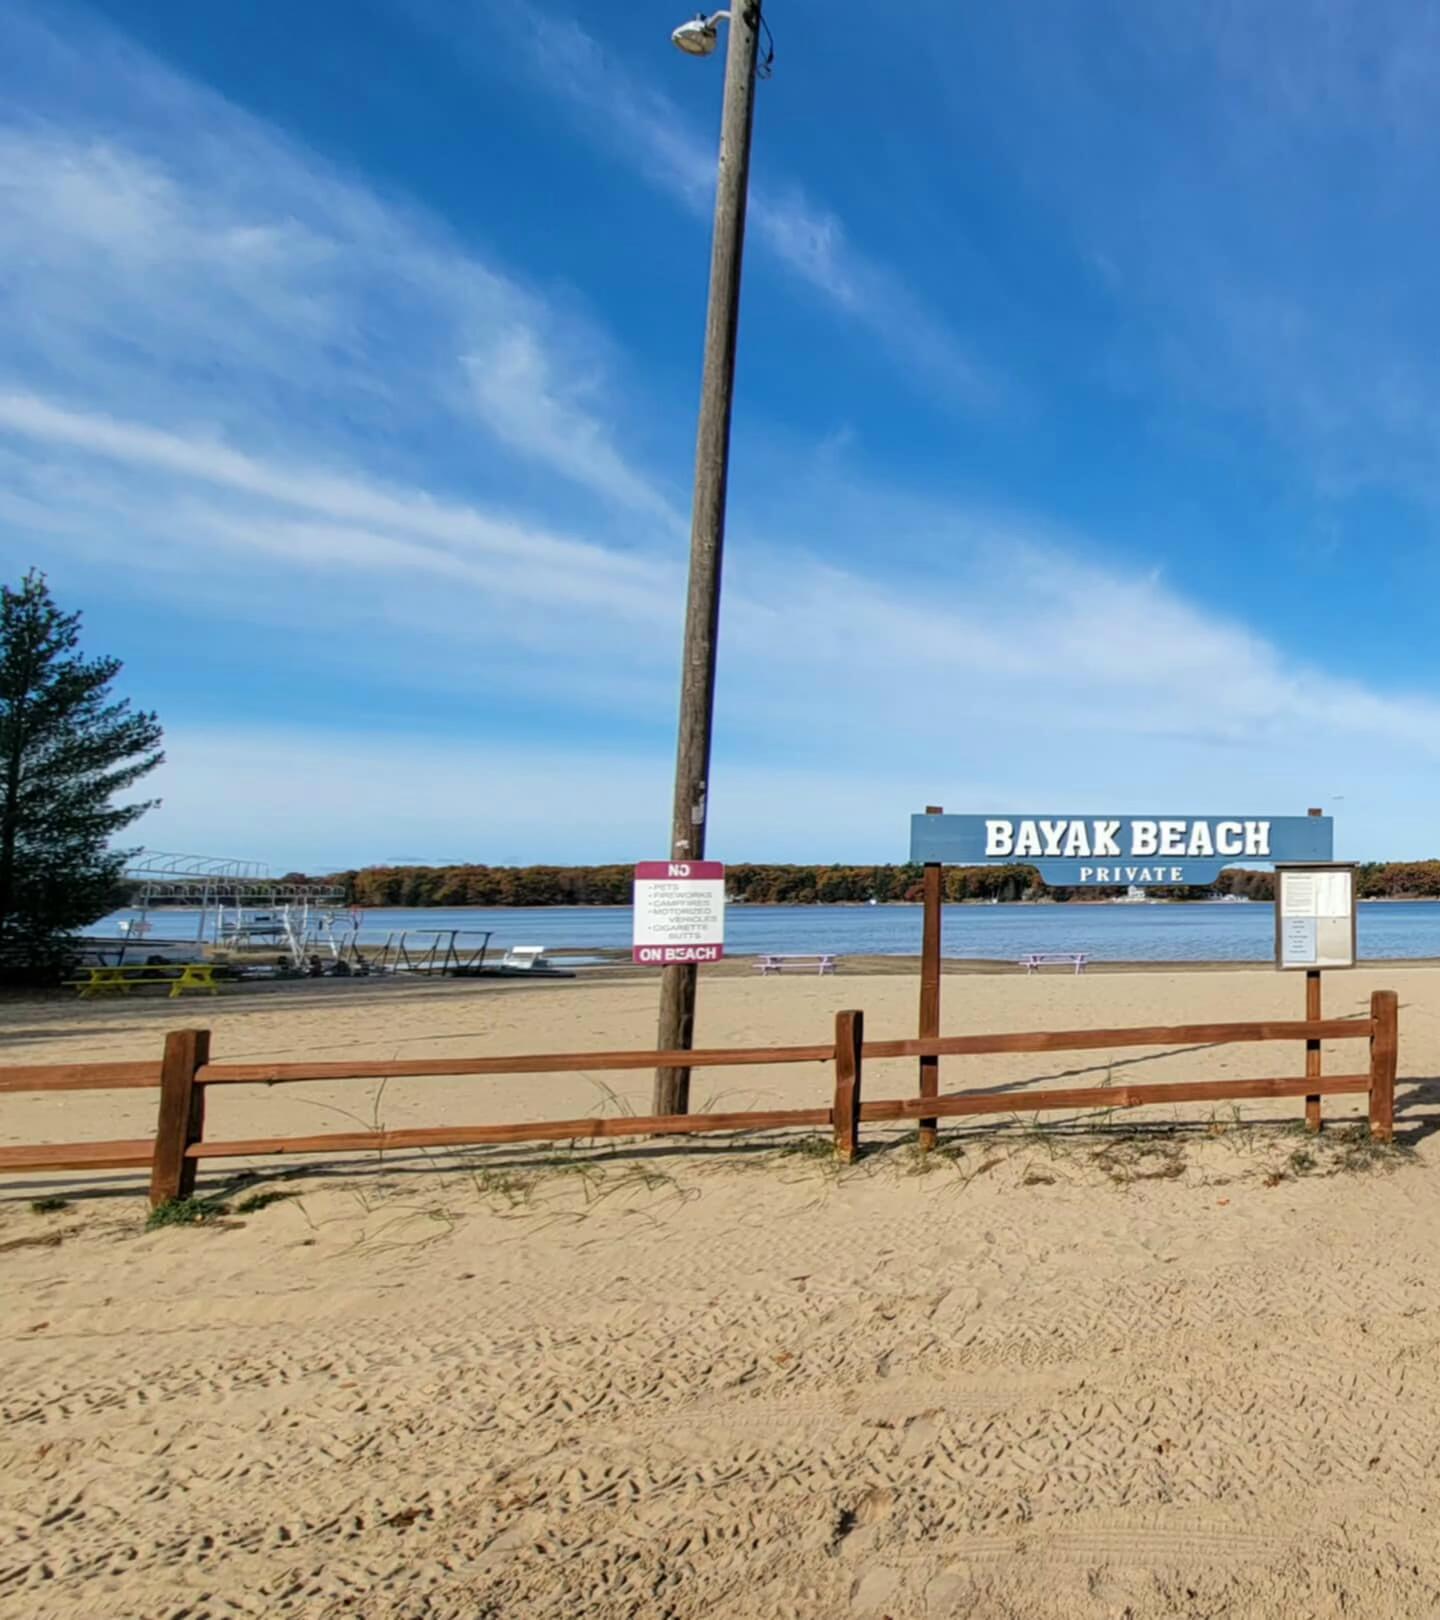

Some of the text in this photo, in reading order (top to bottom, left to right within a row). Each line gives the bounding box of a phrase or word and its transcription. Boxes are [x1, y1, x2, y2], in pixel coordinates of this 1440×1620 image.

[985, 820, 1271, 856] BAYAK BEACH
[668, 864, 690, 876] NO
[1080, 867, 1184, 882] PRIVATE
[640, 947, 716, 961] ON BEACH
